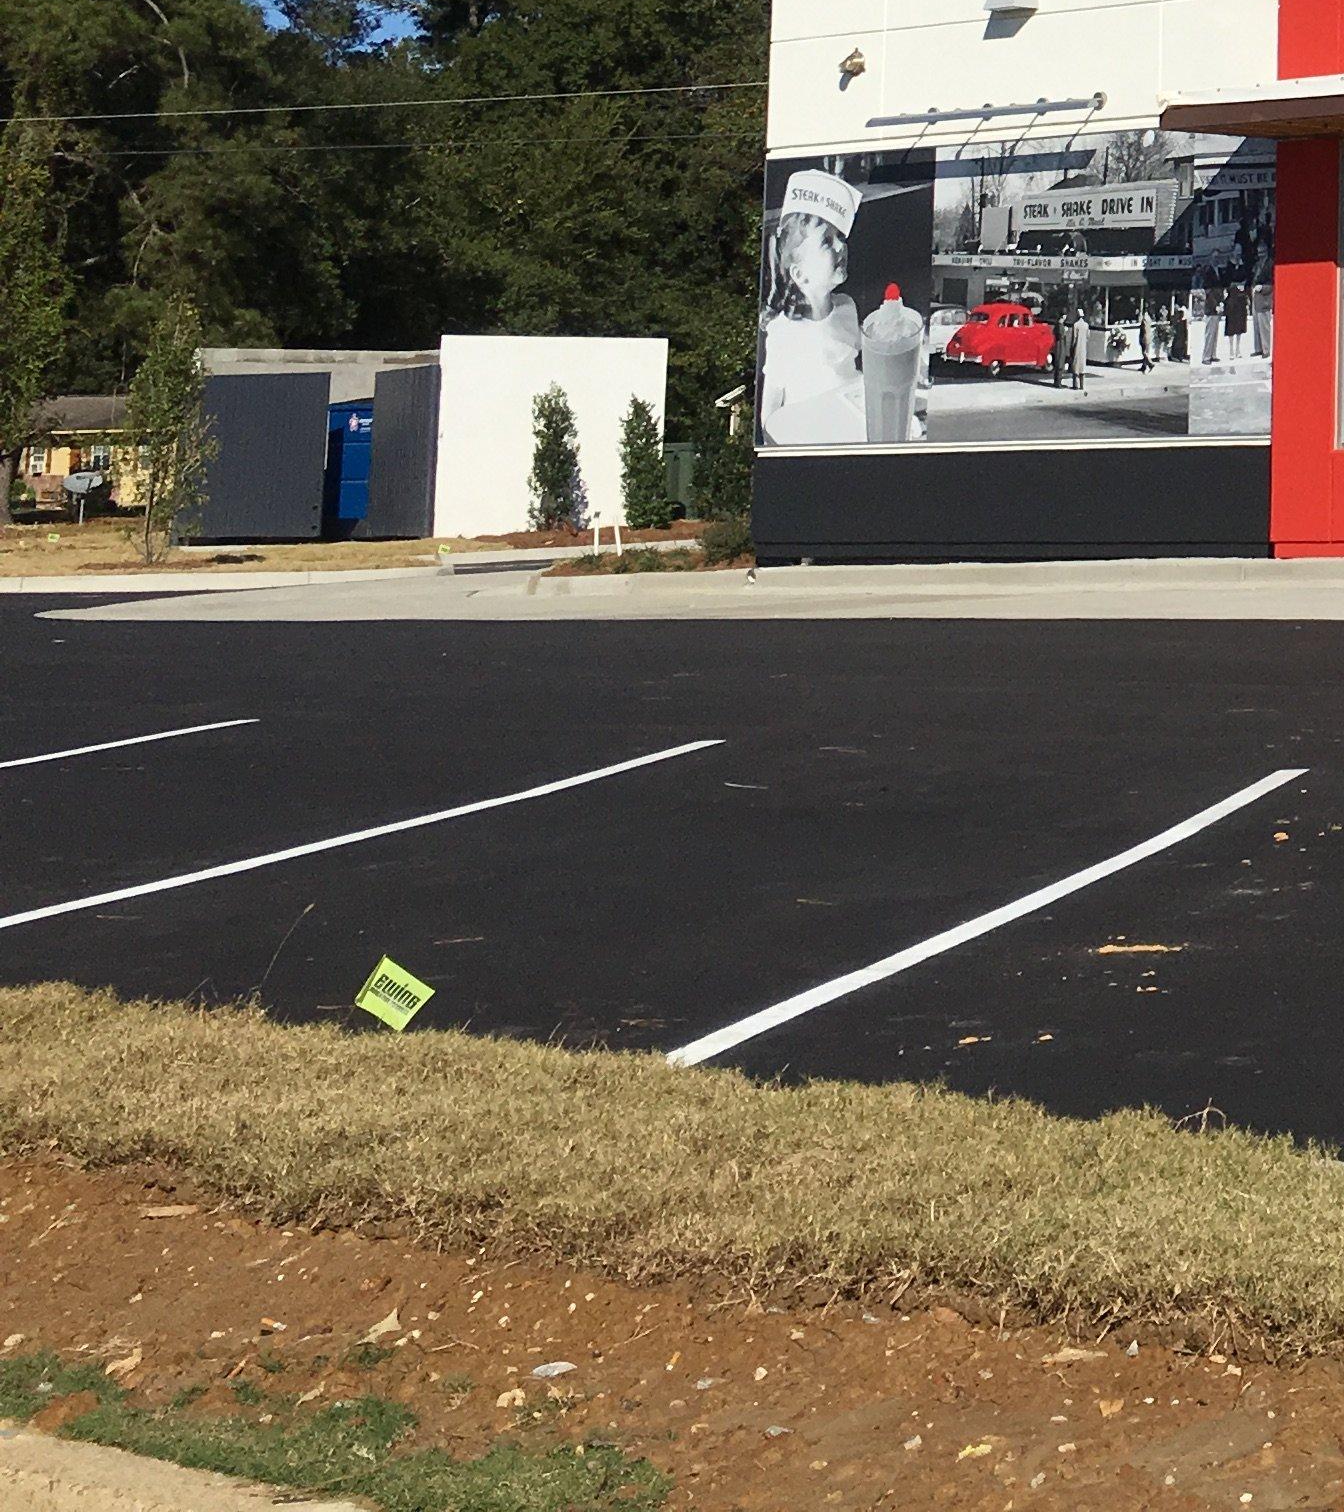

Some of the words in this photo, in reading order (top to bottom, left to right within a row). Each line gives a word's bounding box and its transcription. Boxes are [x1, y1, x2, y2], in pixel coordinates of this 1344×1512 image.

[792, 188, 820, 203] STEAK
[1023, 203, 1050, 219] STEAK
[1061, 199, 1093, 217] SHAKE
[1101, 196, 1134, 215] DRIVE
[1140, 196, 1155, 213] IN
